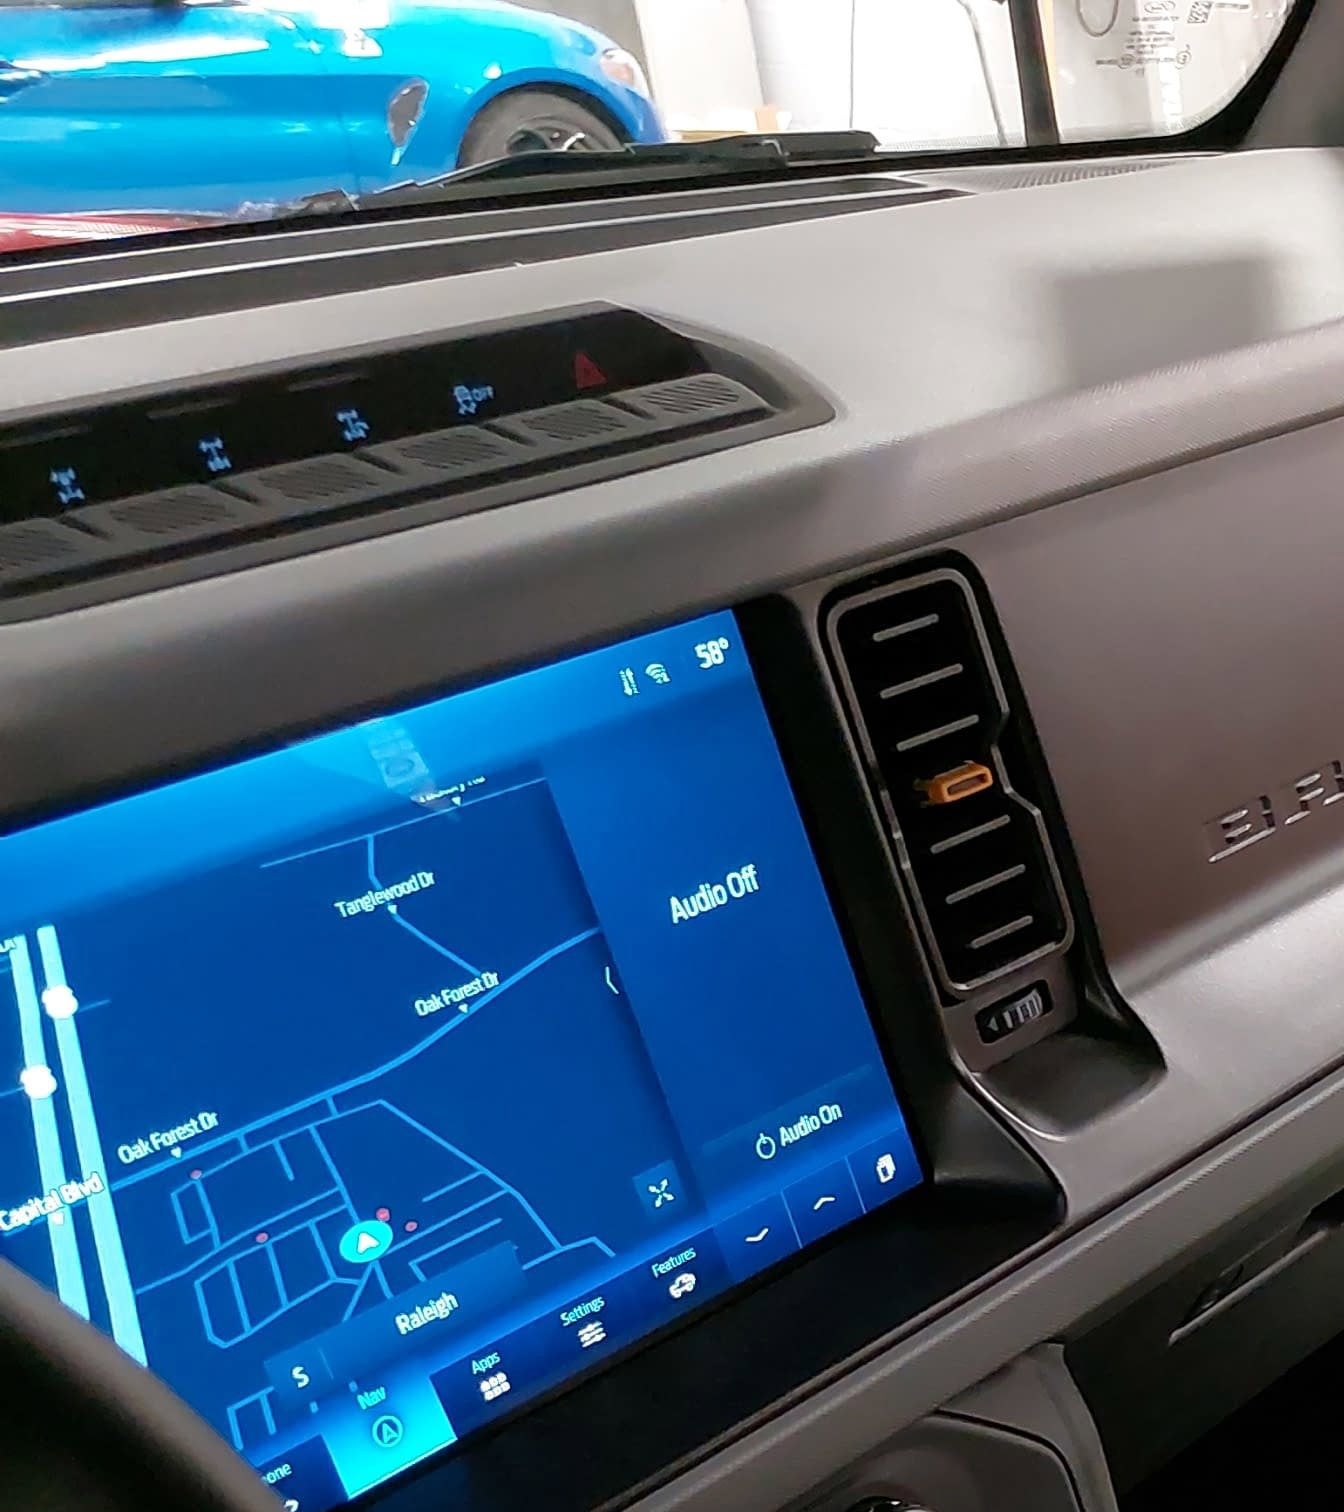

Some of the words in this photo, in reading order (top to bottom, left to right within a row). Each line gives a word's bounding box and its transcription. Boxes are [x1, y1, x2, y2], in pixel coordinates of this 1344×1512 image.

[694, 637, 729, 669] 58°
[334, 874, 419, 917] Tanglewood
[417, 871, 435, 889] Dr
[669, 883, 728, 924] Audio
[726, 864, 759, 899] Off
[415, 993, 444, 1017] Oak
[443, 978, 484, 1006] Forest
[482, 971, 500, 990] Dr
[118, 1139, 151, 1165] Oak
[150, 1118, 201, 1149] Forest
[199, 1111, 220, 1131] Dr
[779, 1113, 821, 1147] Audio
[818, 1103, 843, 1126] On
[0, 1187, 60, 1231] Capital
[58, 1171, 105, 1205] Blvd
[651, 1247, 697, 1279] Features
[395, 1291, 459, 1335] Raleigh
[560, 1296, 605, 1327] Settings
[292, 1366, 310, 1388] S
[471, 1352, 501, 1375] Apps
[356, 1386, 387, 1411] Nav
